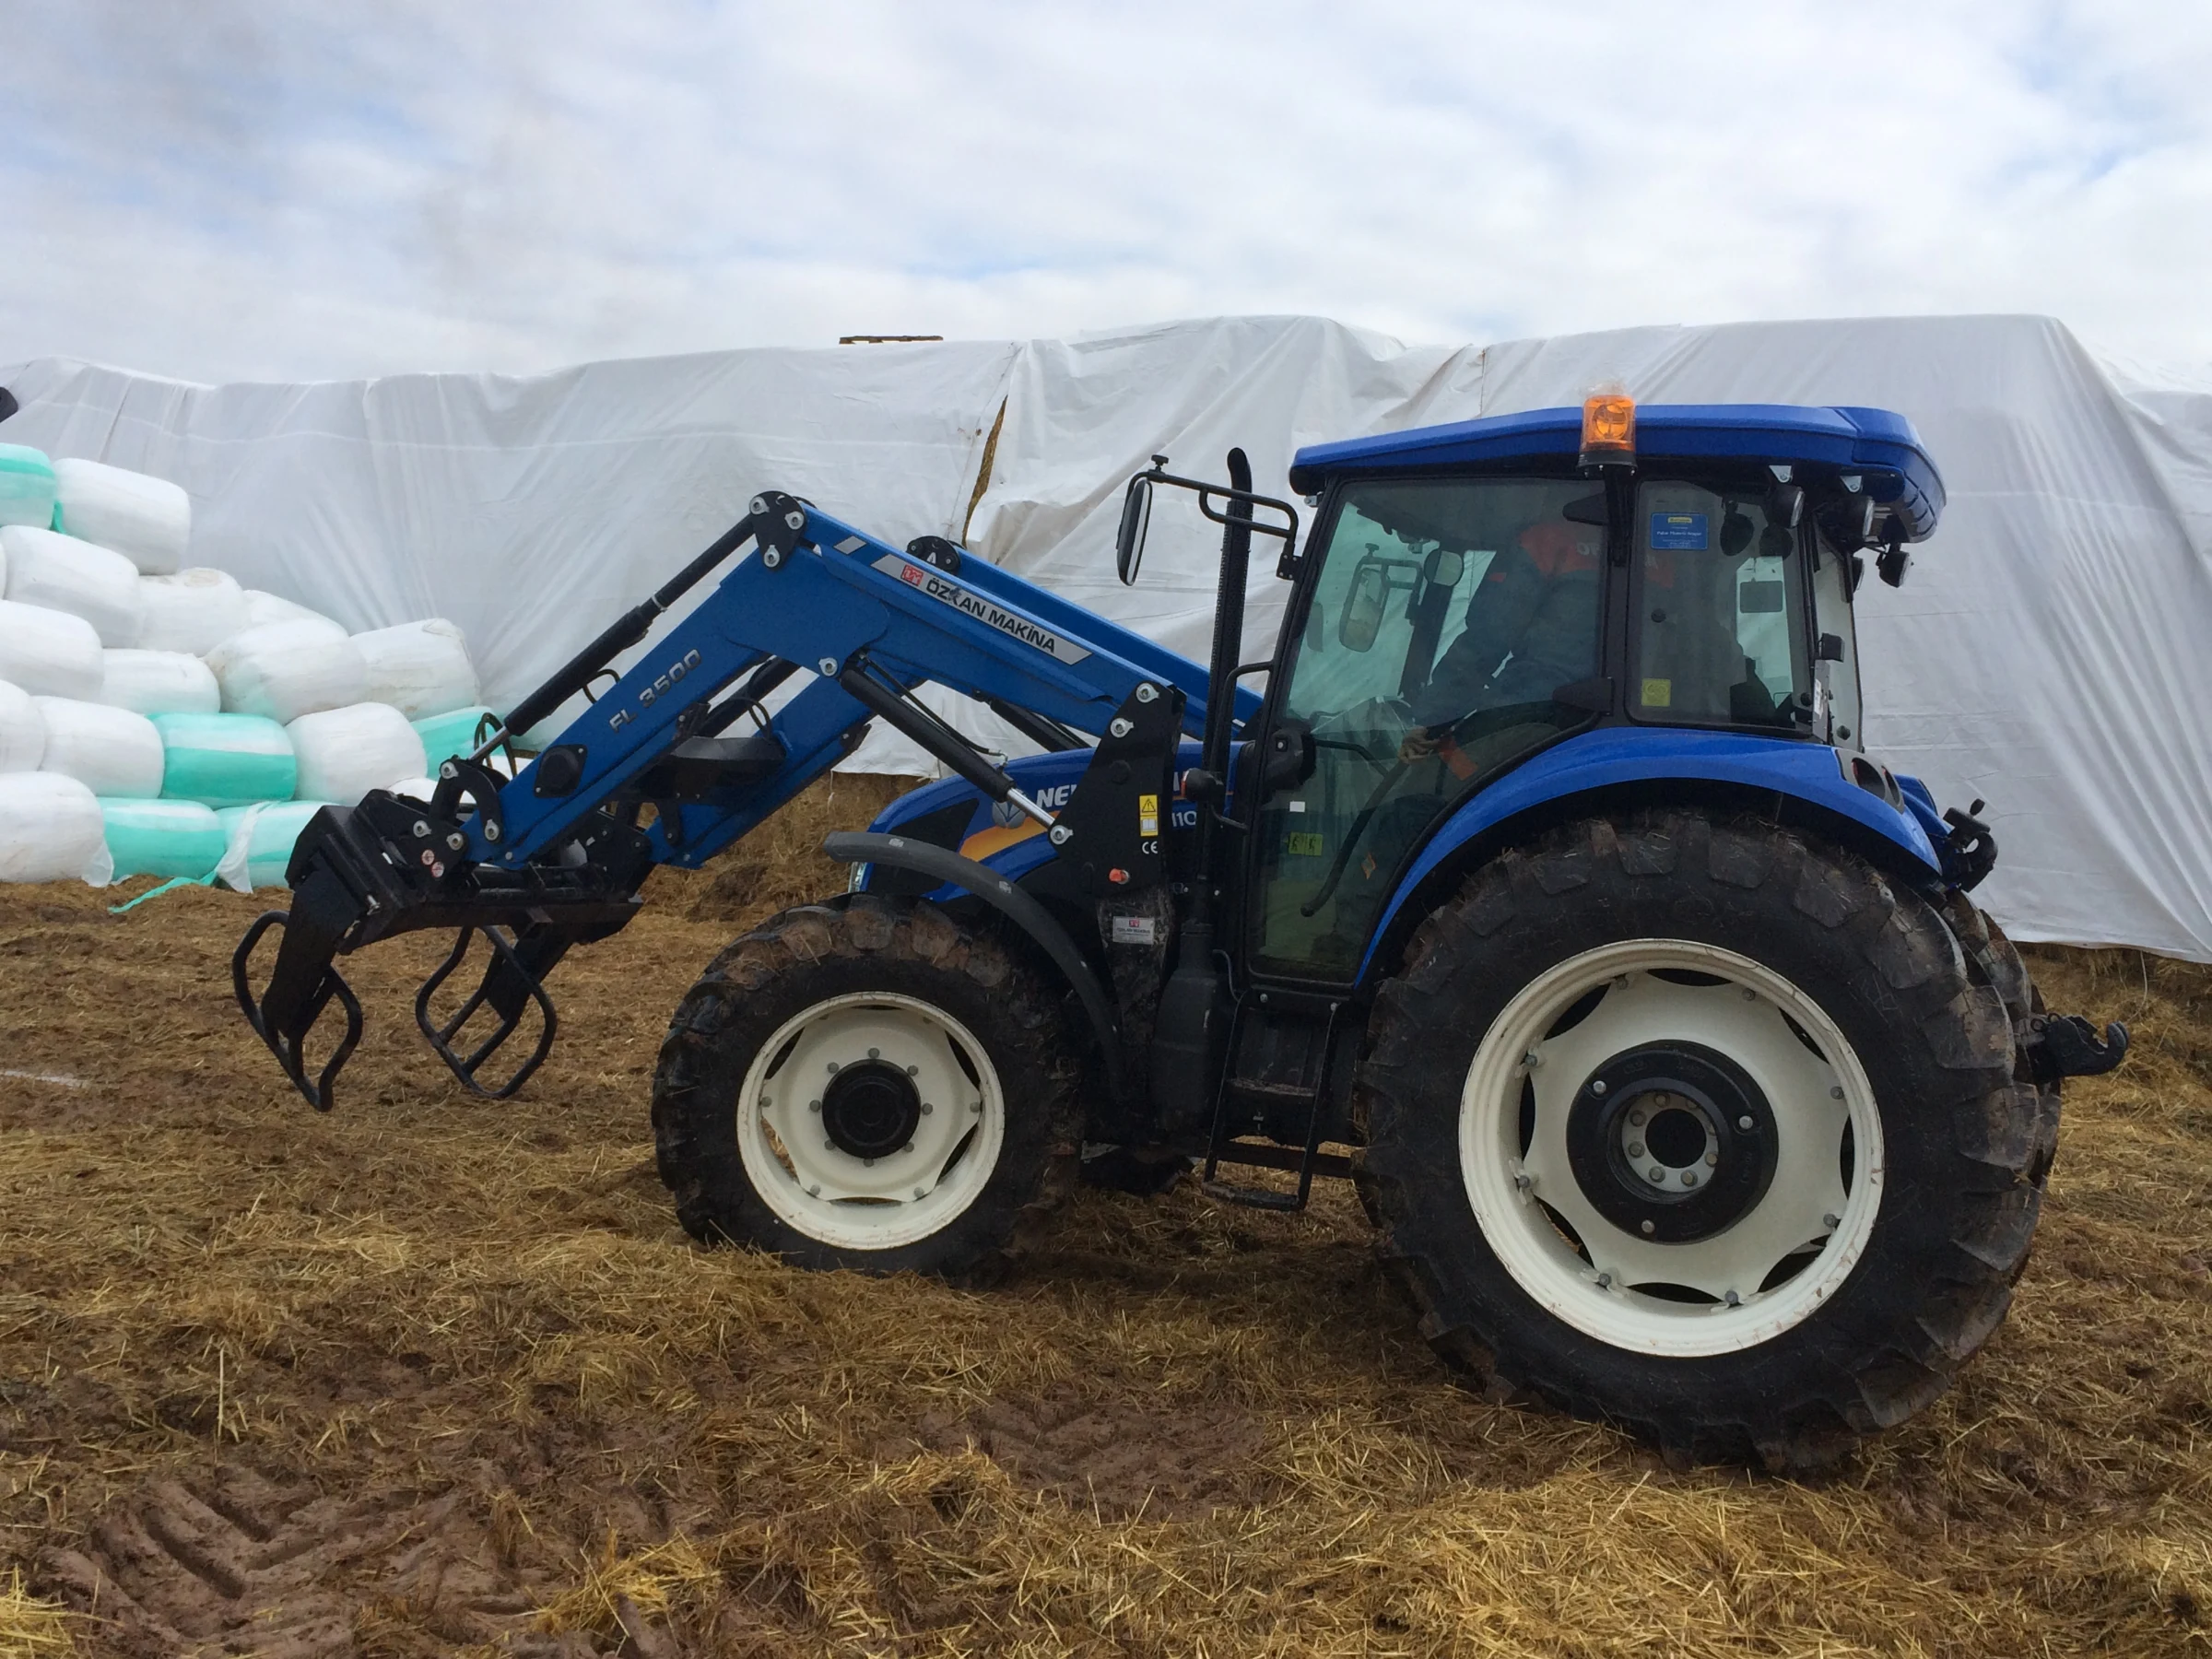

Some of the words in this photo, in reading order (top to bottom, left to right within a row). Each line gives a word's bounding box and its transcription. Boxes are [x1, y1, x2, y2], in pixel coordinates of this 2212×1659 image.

[987, 609, 1055, 653] MAKİNA
[609, 709, 638, 733] FL
[639, 649, 701, 708] 3500
